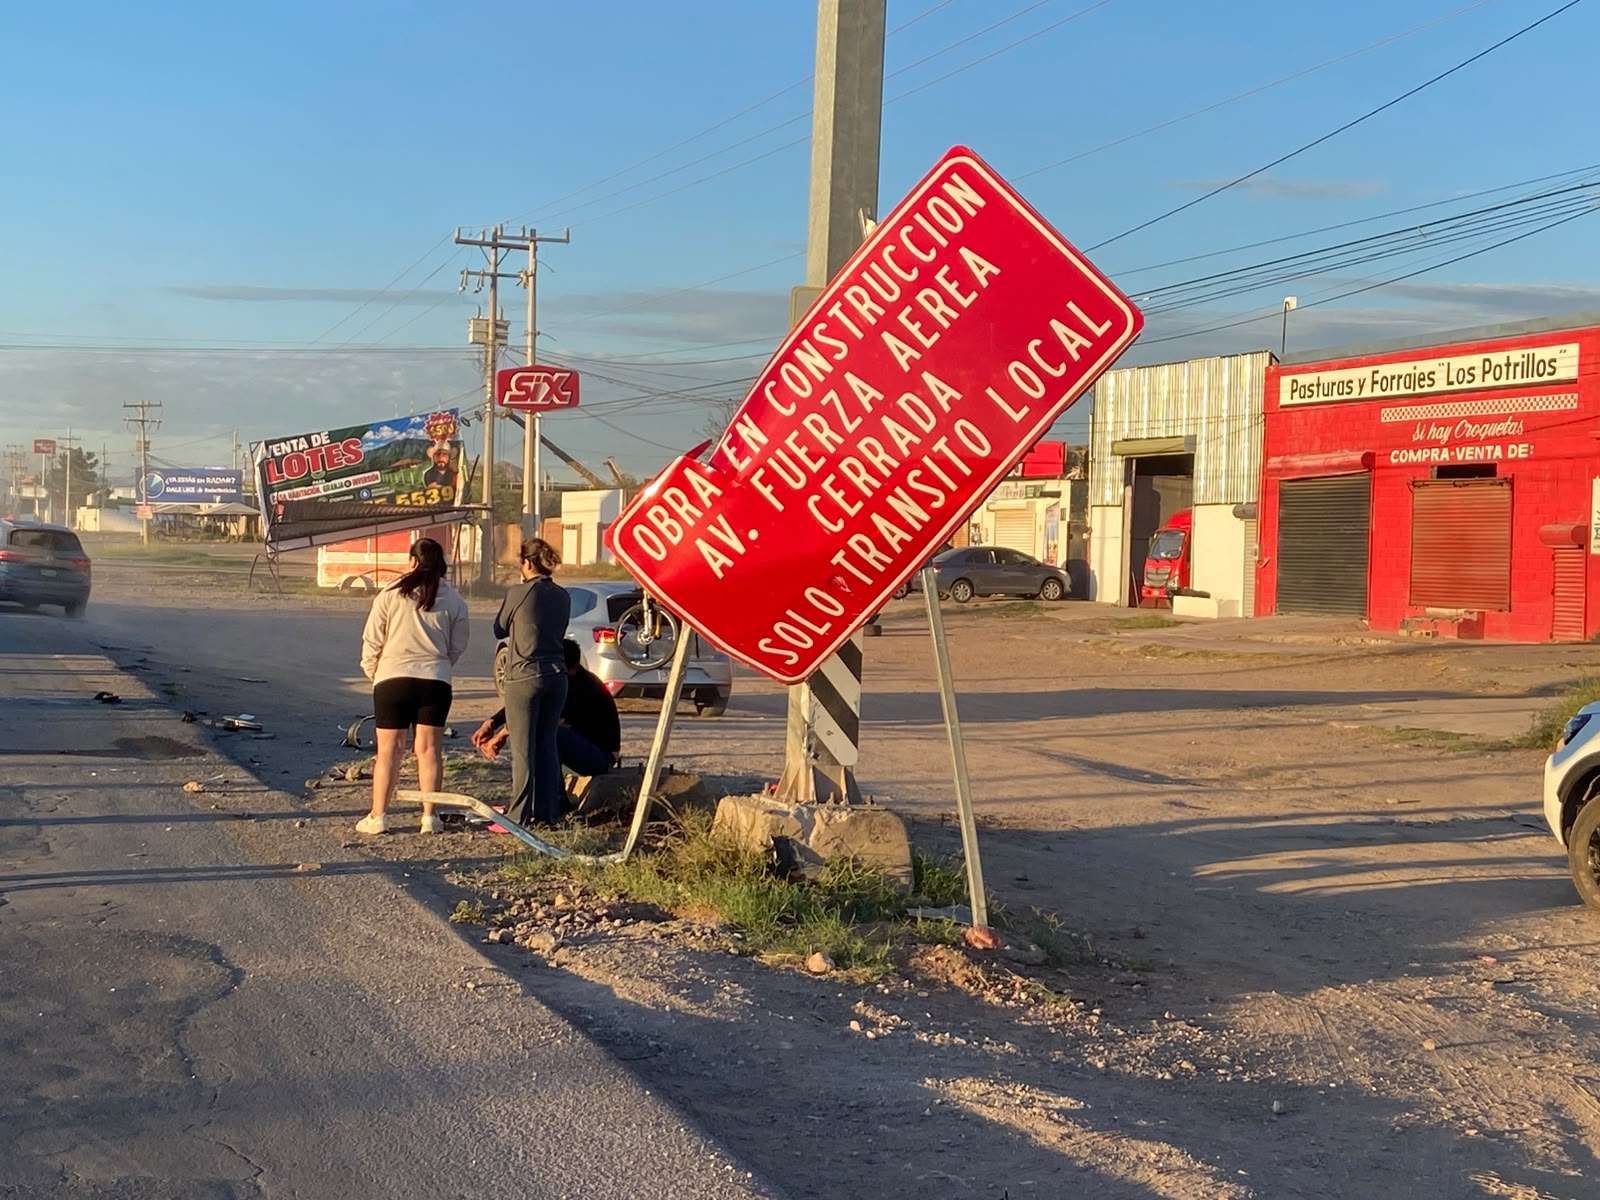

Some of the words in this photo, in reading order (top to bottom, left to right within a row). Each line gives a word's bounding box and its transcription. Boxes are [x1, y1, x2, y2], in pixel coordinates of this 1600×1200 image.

[632, 467, 723, 561] OBRA
[721, 412, 769, 473] EN
[764, 172, 986, 417] CONSTRUCCION
[1290, 376, 1354, 400] Pasturas
[1358, 377, 1367, 396] y
[1371, 366, 1436, 392] Forrajes
[694, 513, 760, 580] AV.
[750, 371, 885, 512] FUERZA
[880, 245, 1001, 373] AEREA
[1427, 422, 1453, 445] hay
[1454, 416, 1524, 441] Croquetas
[264, 438, 364, 485] LOTES
[311, 431, 330, 447] DE
[807, 372, 963, 533] CERRADA
[1390, 445, 1503, 464] COMPRA-VENTA
[1507, 444, 1535, 459] DE:
[758, 587, 845, 666] SOLO
[830, 418, 992, 586] TRANSITO
[984, 300, 1113, 424] LOCAL
